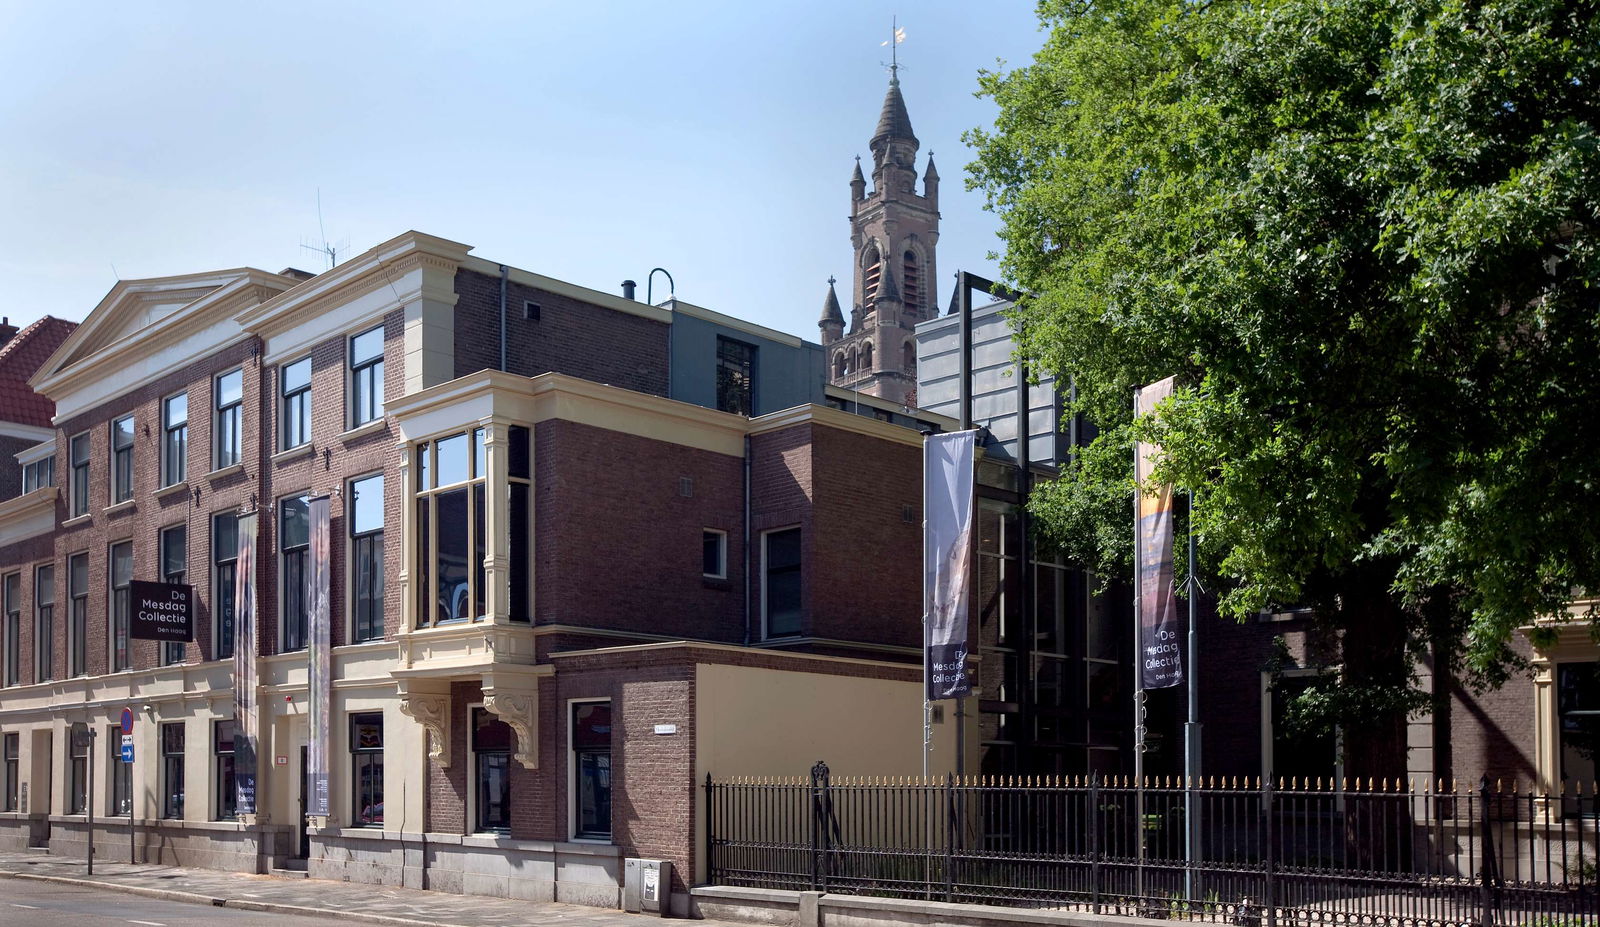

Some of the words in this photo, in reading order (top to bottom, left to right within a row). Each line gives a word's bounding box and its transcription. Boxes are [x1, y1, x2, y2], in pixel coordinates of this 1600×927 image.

[171, 590, 186, 601] De
[142, 599, 186, 613] Mesdag
[138, 610, 186, 624] Collectie
[1160, 630, 1176, 641] De
